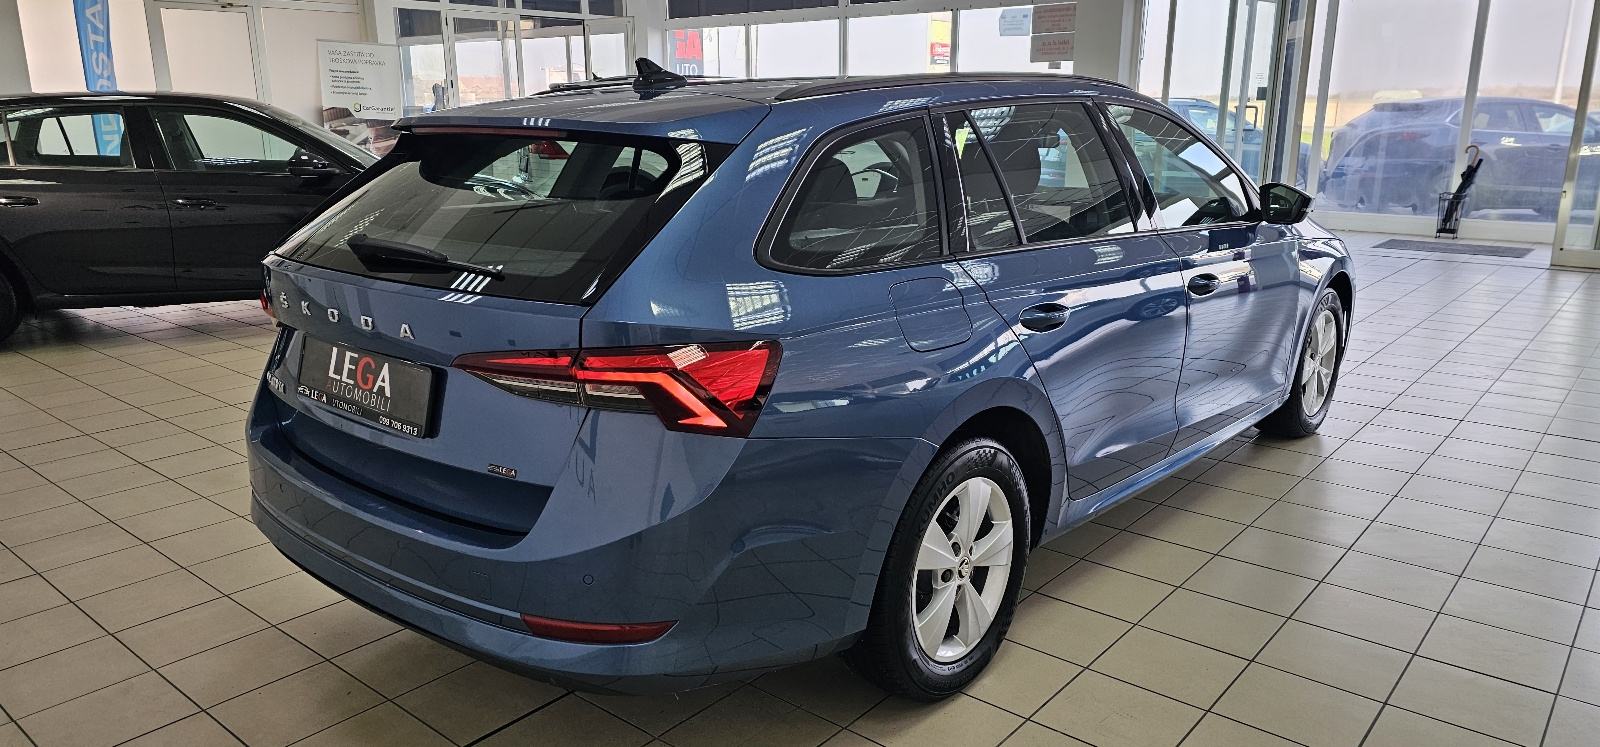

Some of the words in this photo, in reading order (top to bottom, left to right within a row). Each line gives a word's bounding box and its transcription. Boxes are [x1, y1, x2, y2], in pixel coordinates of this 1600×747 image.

[279, 291, 416, 340] ŠKODA
[328, 346, 391, 398] LEGA
[311, 389, 327, 404] LEGA
[379, 415, 390, 427] 099
[391, 420, 402, 431] 706
[402, 424, 418, 436] 9313
